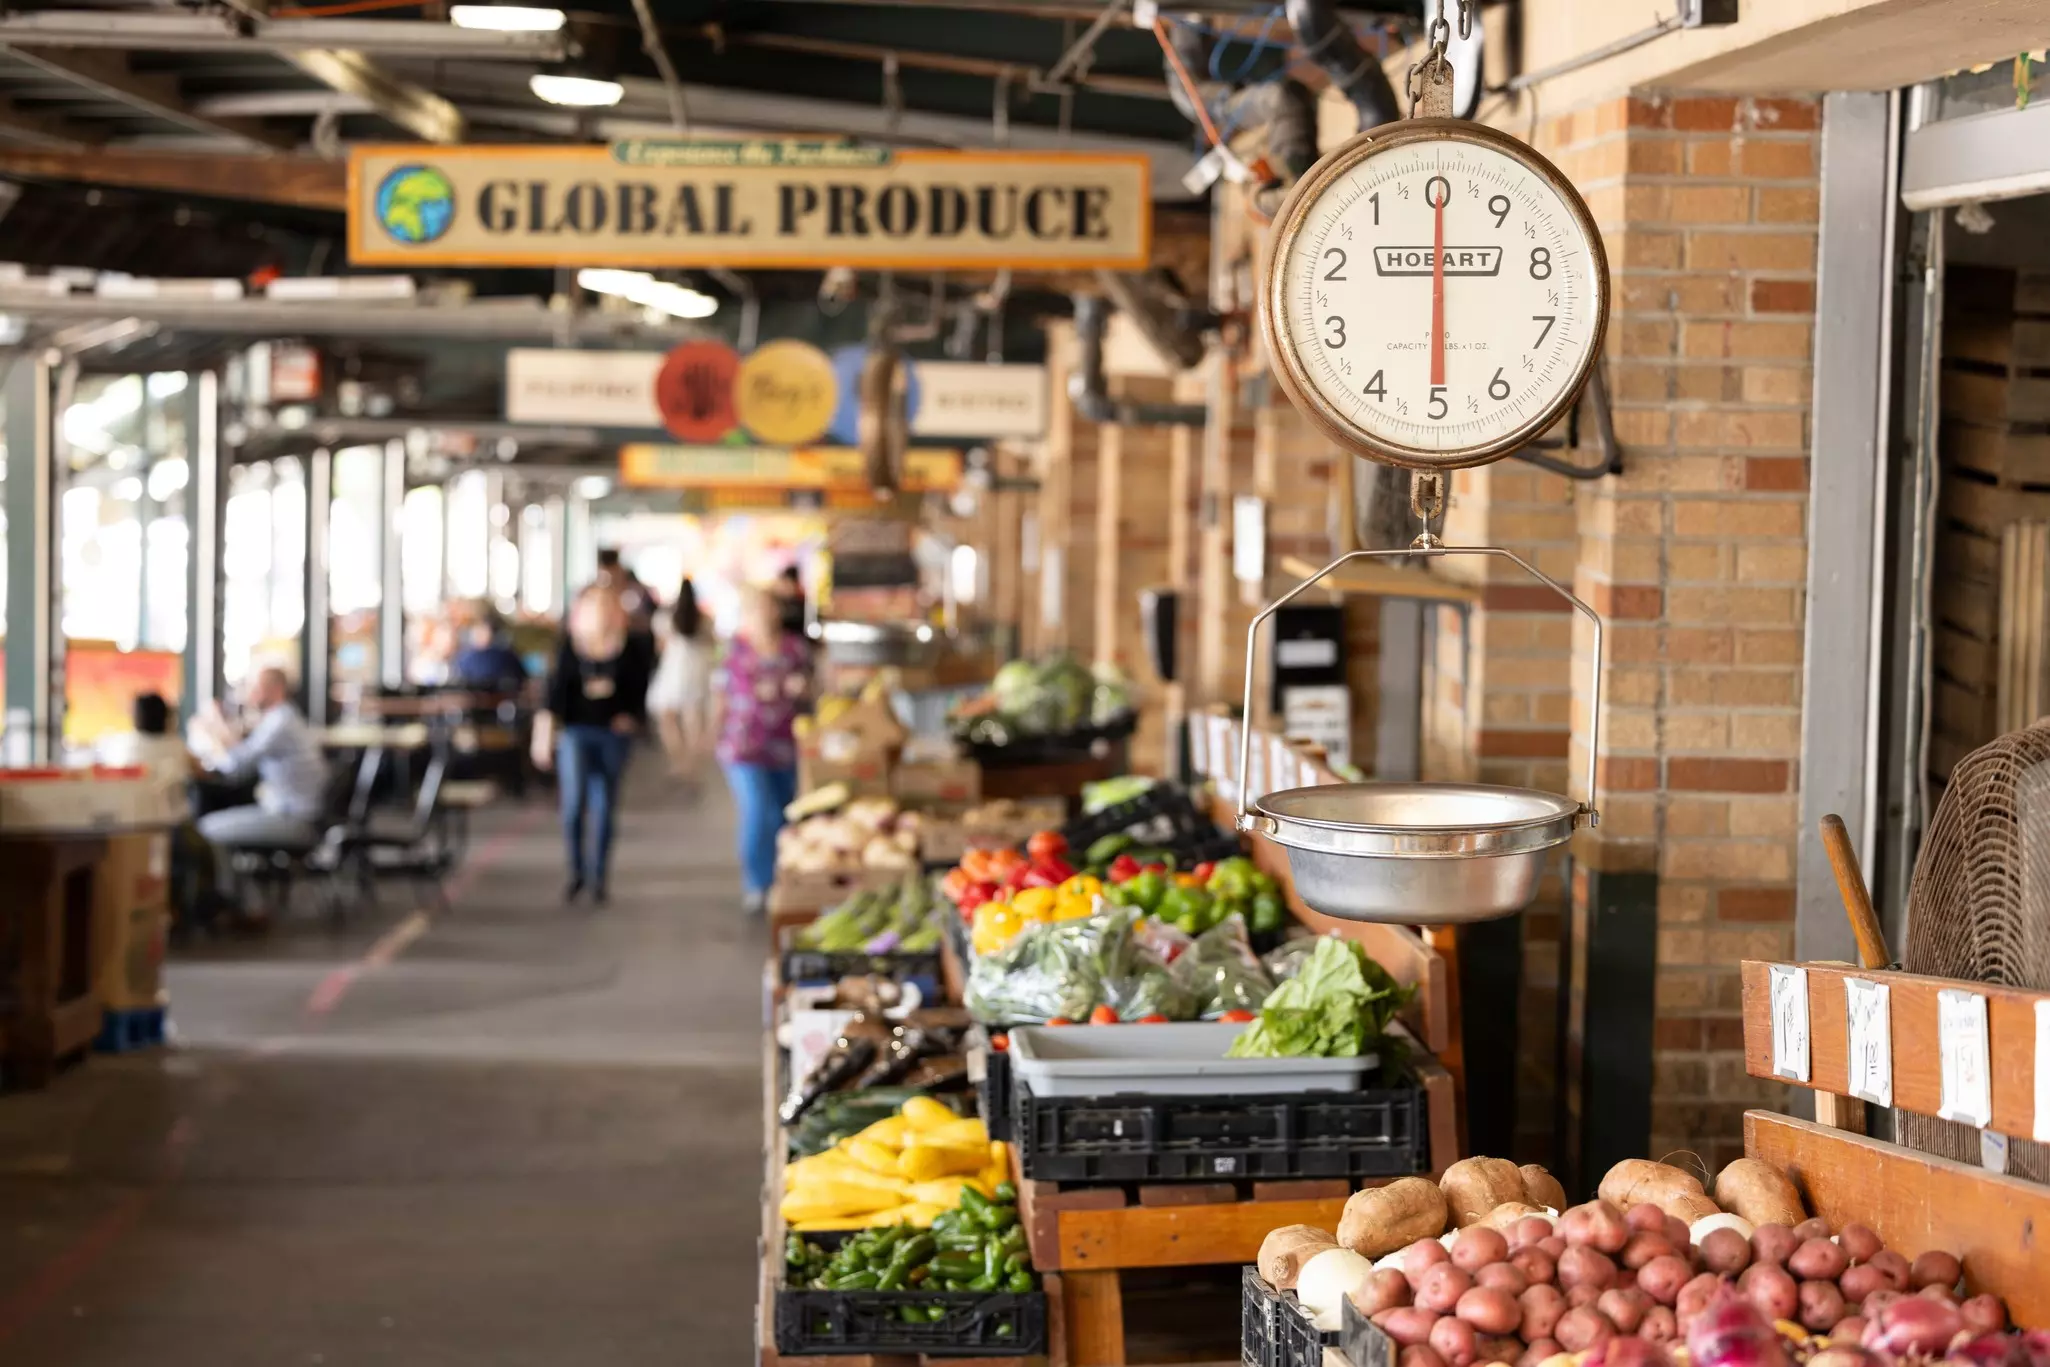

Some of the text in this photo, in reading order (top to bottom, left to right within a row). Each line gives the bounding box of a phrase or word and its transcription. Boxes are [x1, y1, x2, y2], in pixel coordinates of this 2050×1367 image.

[1368, 192, 1380, 226] 1
[1425, 175, 1451, 209] 0
[476, 180, 1111, 241] GLOBAL PRODUCE
[1488, 195, 1511, 229] 9
[1323, 247, 1347, 282] 2
[1387, 252, 1492, 267] HOBART
[1529, 246, 1552, 281] 8
[1324, 315, 1347, 350] 3
[1386, 342, 1428, 351] CAPACITY
[1532, 315, 1556, 350] 7
[1362, 369, 1388, 404] 4
[1487, 367, 1511, 401] 6
[1427, 386, 1449, 421] 5
